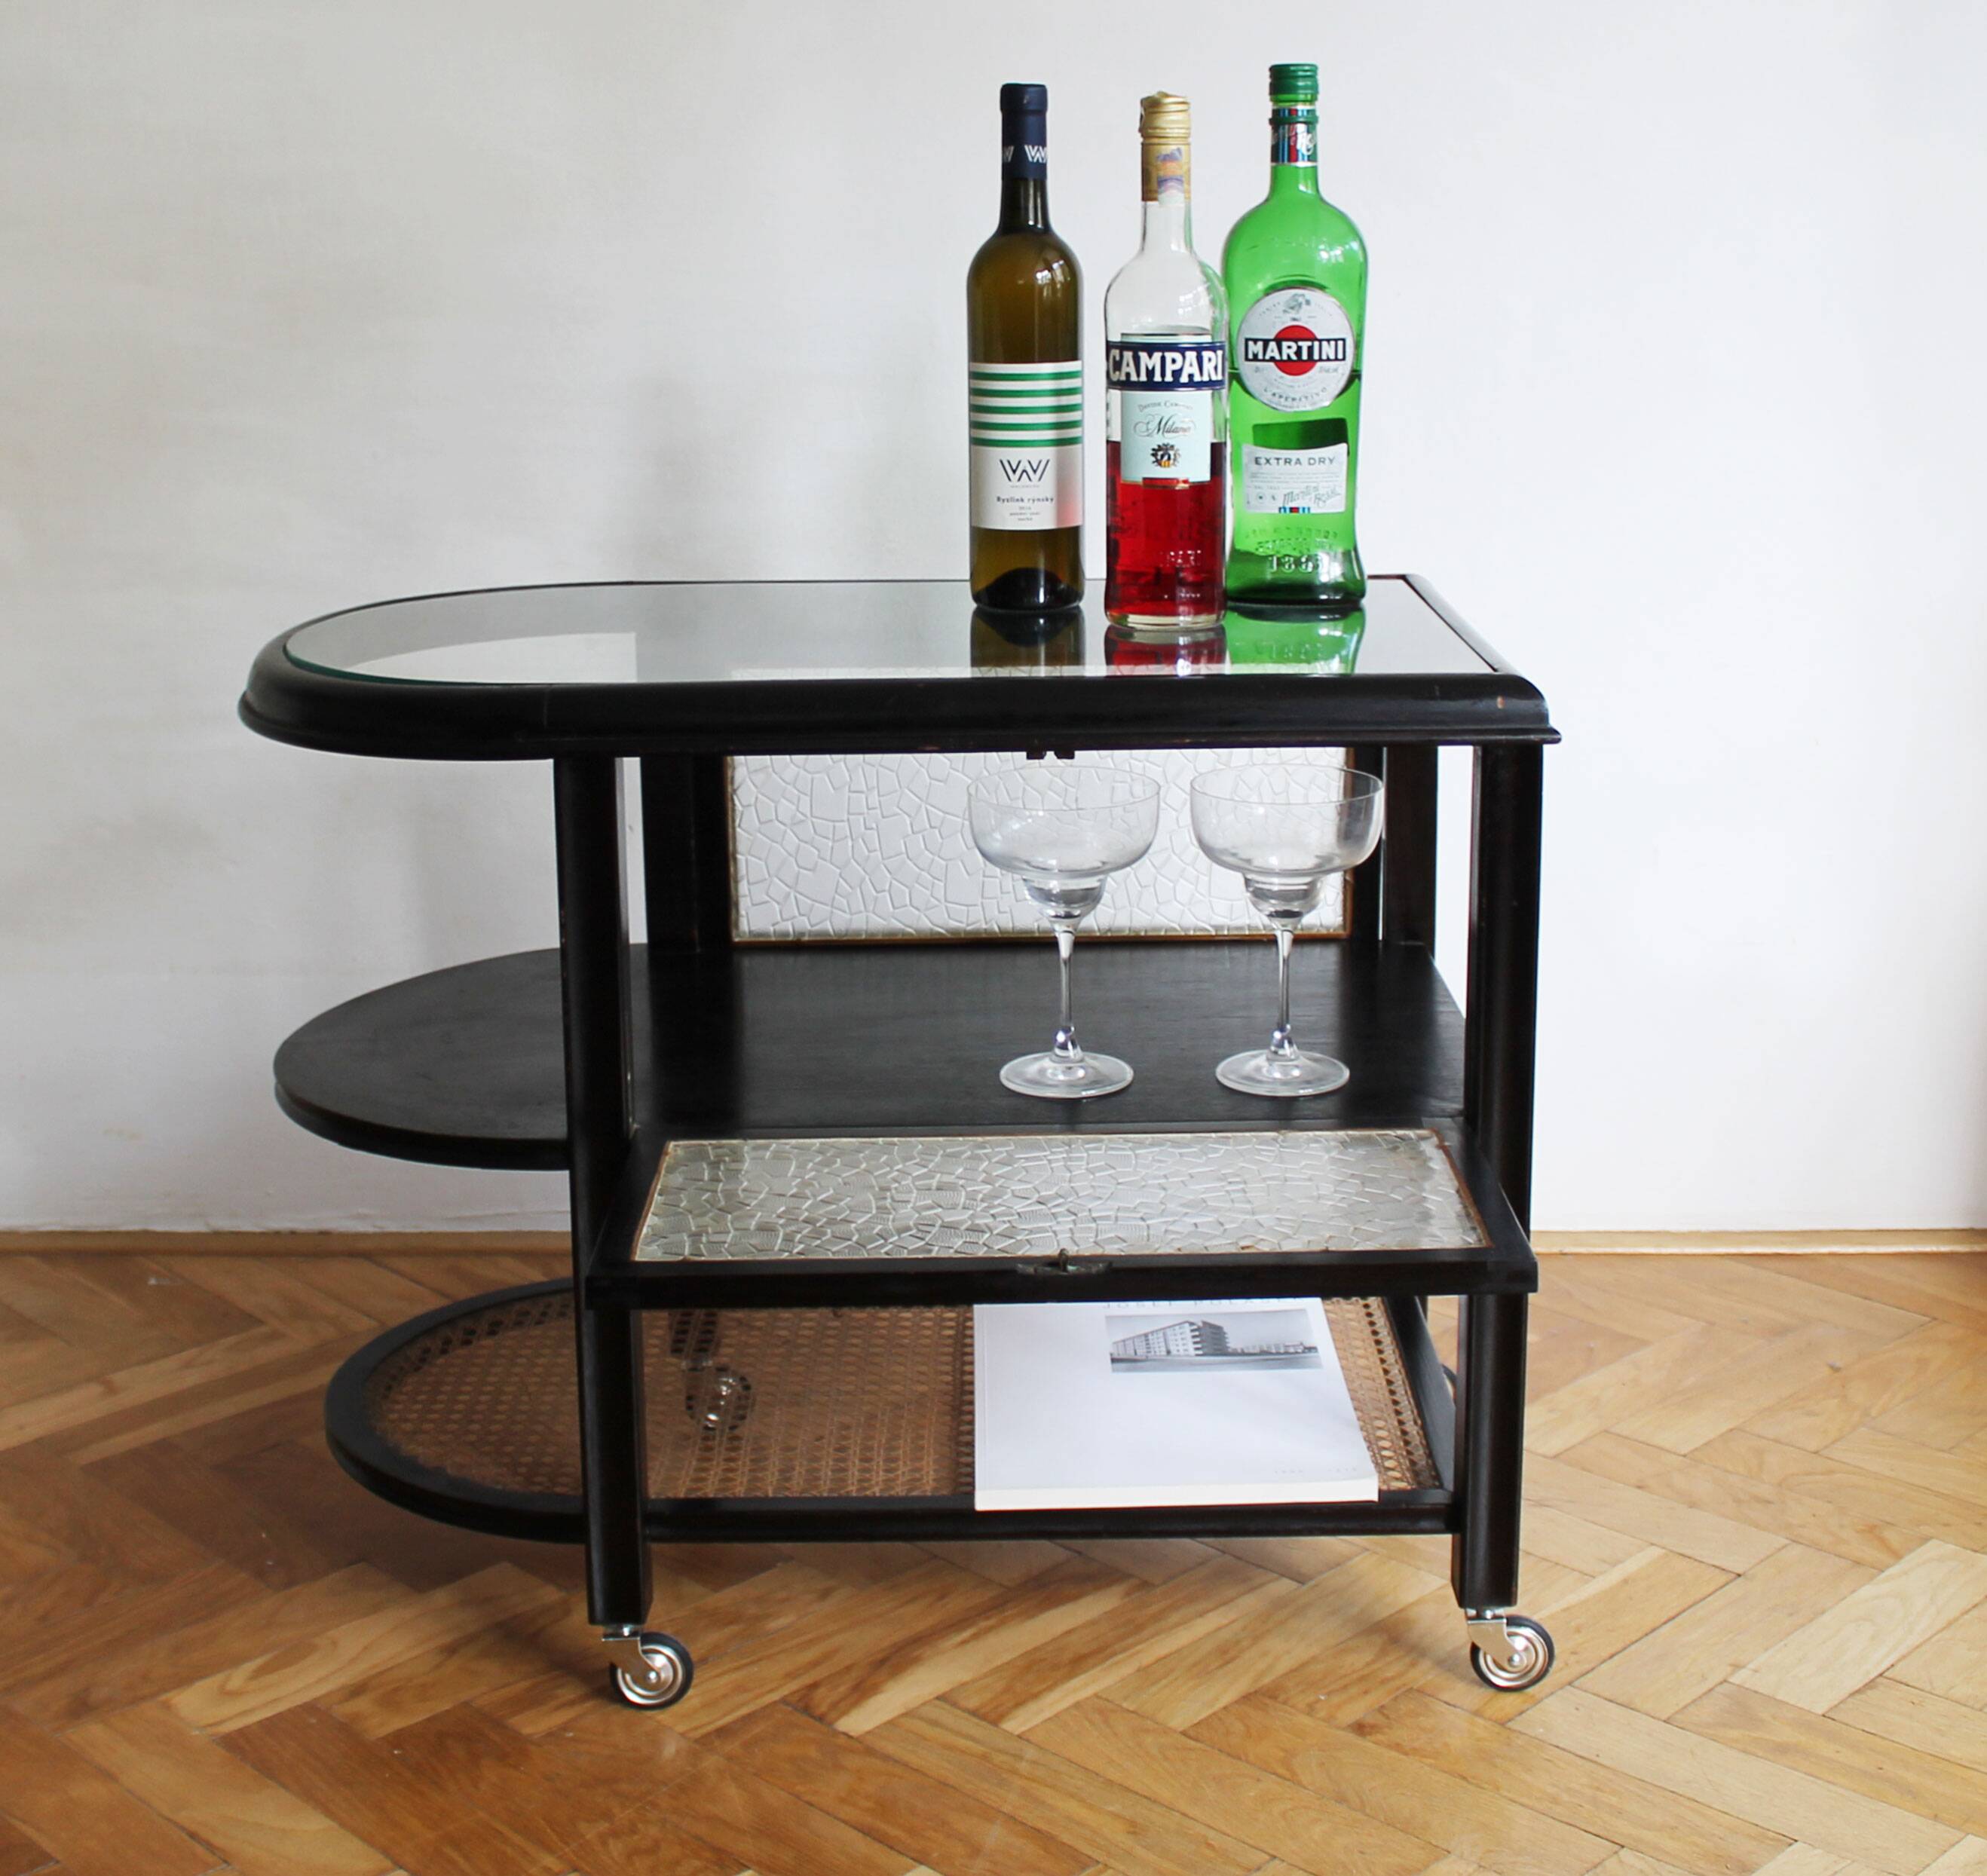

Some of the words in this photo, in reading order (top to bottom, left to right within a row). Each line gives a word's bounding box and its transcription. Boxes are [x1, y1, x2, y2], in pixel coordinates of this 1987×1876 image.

[1248, 341, 1345, 360] MARTINI
[1109, 348, 1223, 383] CAMPARI
[1254, 457, 1303, 466] EXTRA
[1308, 457, 1336, 466] DRY
